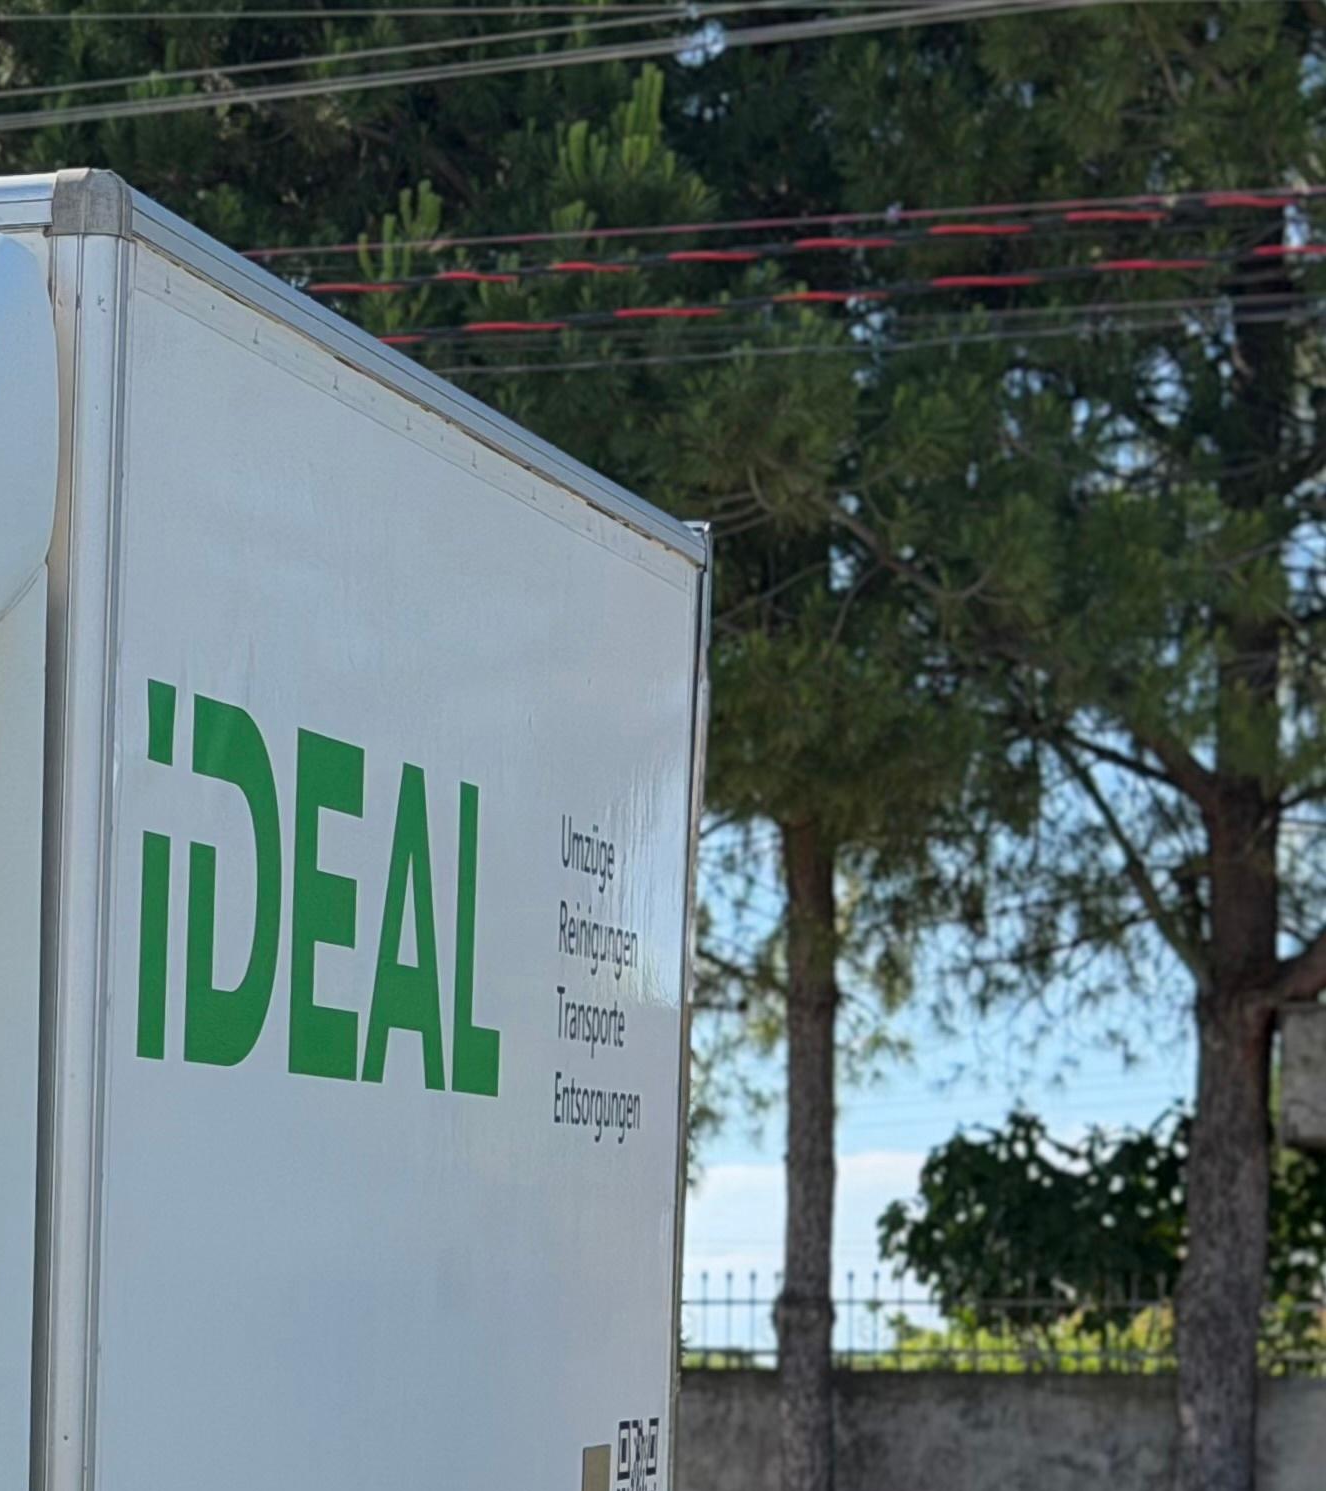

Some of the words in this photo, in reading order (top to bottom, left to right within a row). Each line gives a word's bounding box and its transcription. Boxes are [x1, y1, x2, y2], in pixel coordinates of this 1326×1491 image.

[561, 814, 615, 893] Umzüge
[559, 900, 638, 981] Reinigungen
[556, 985, 625, 1059] Transporte
[554, 1071, 641, 1144] Entsorgungen
